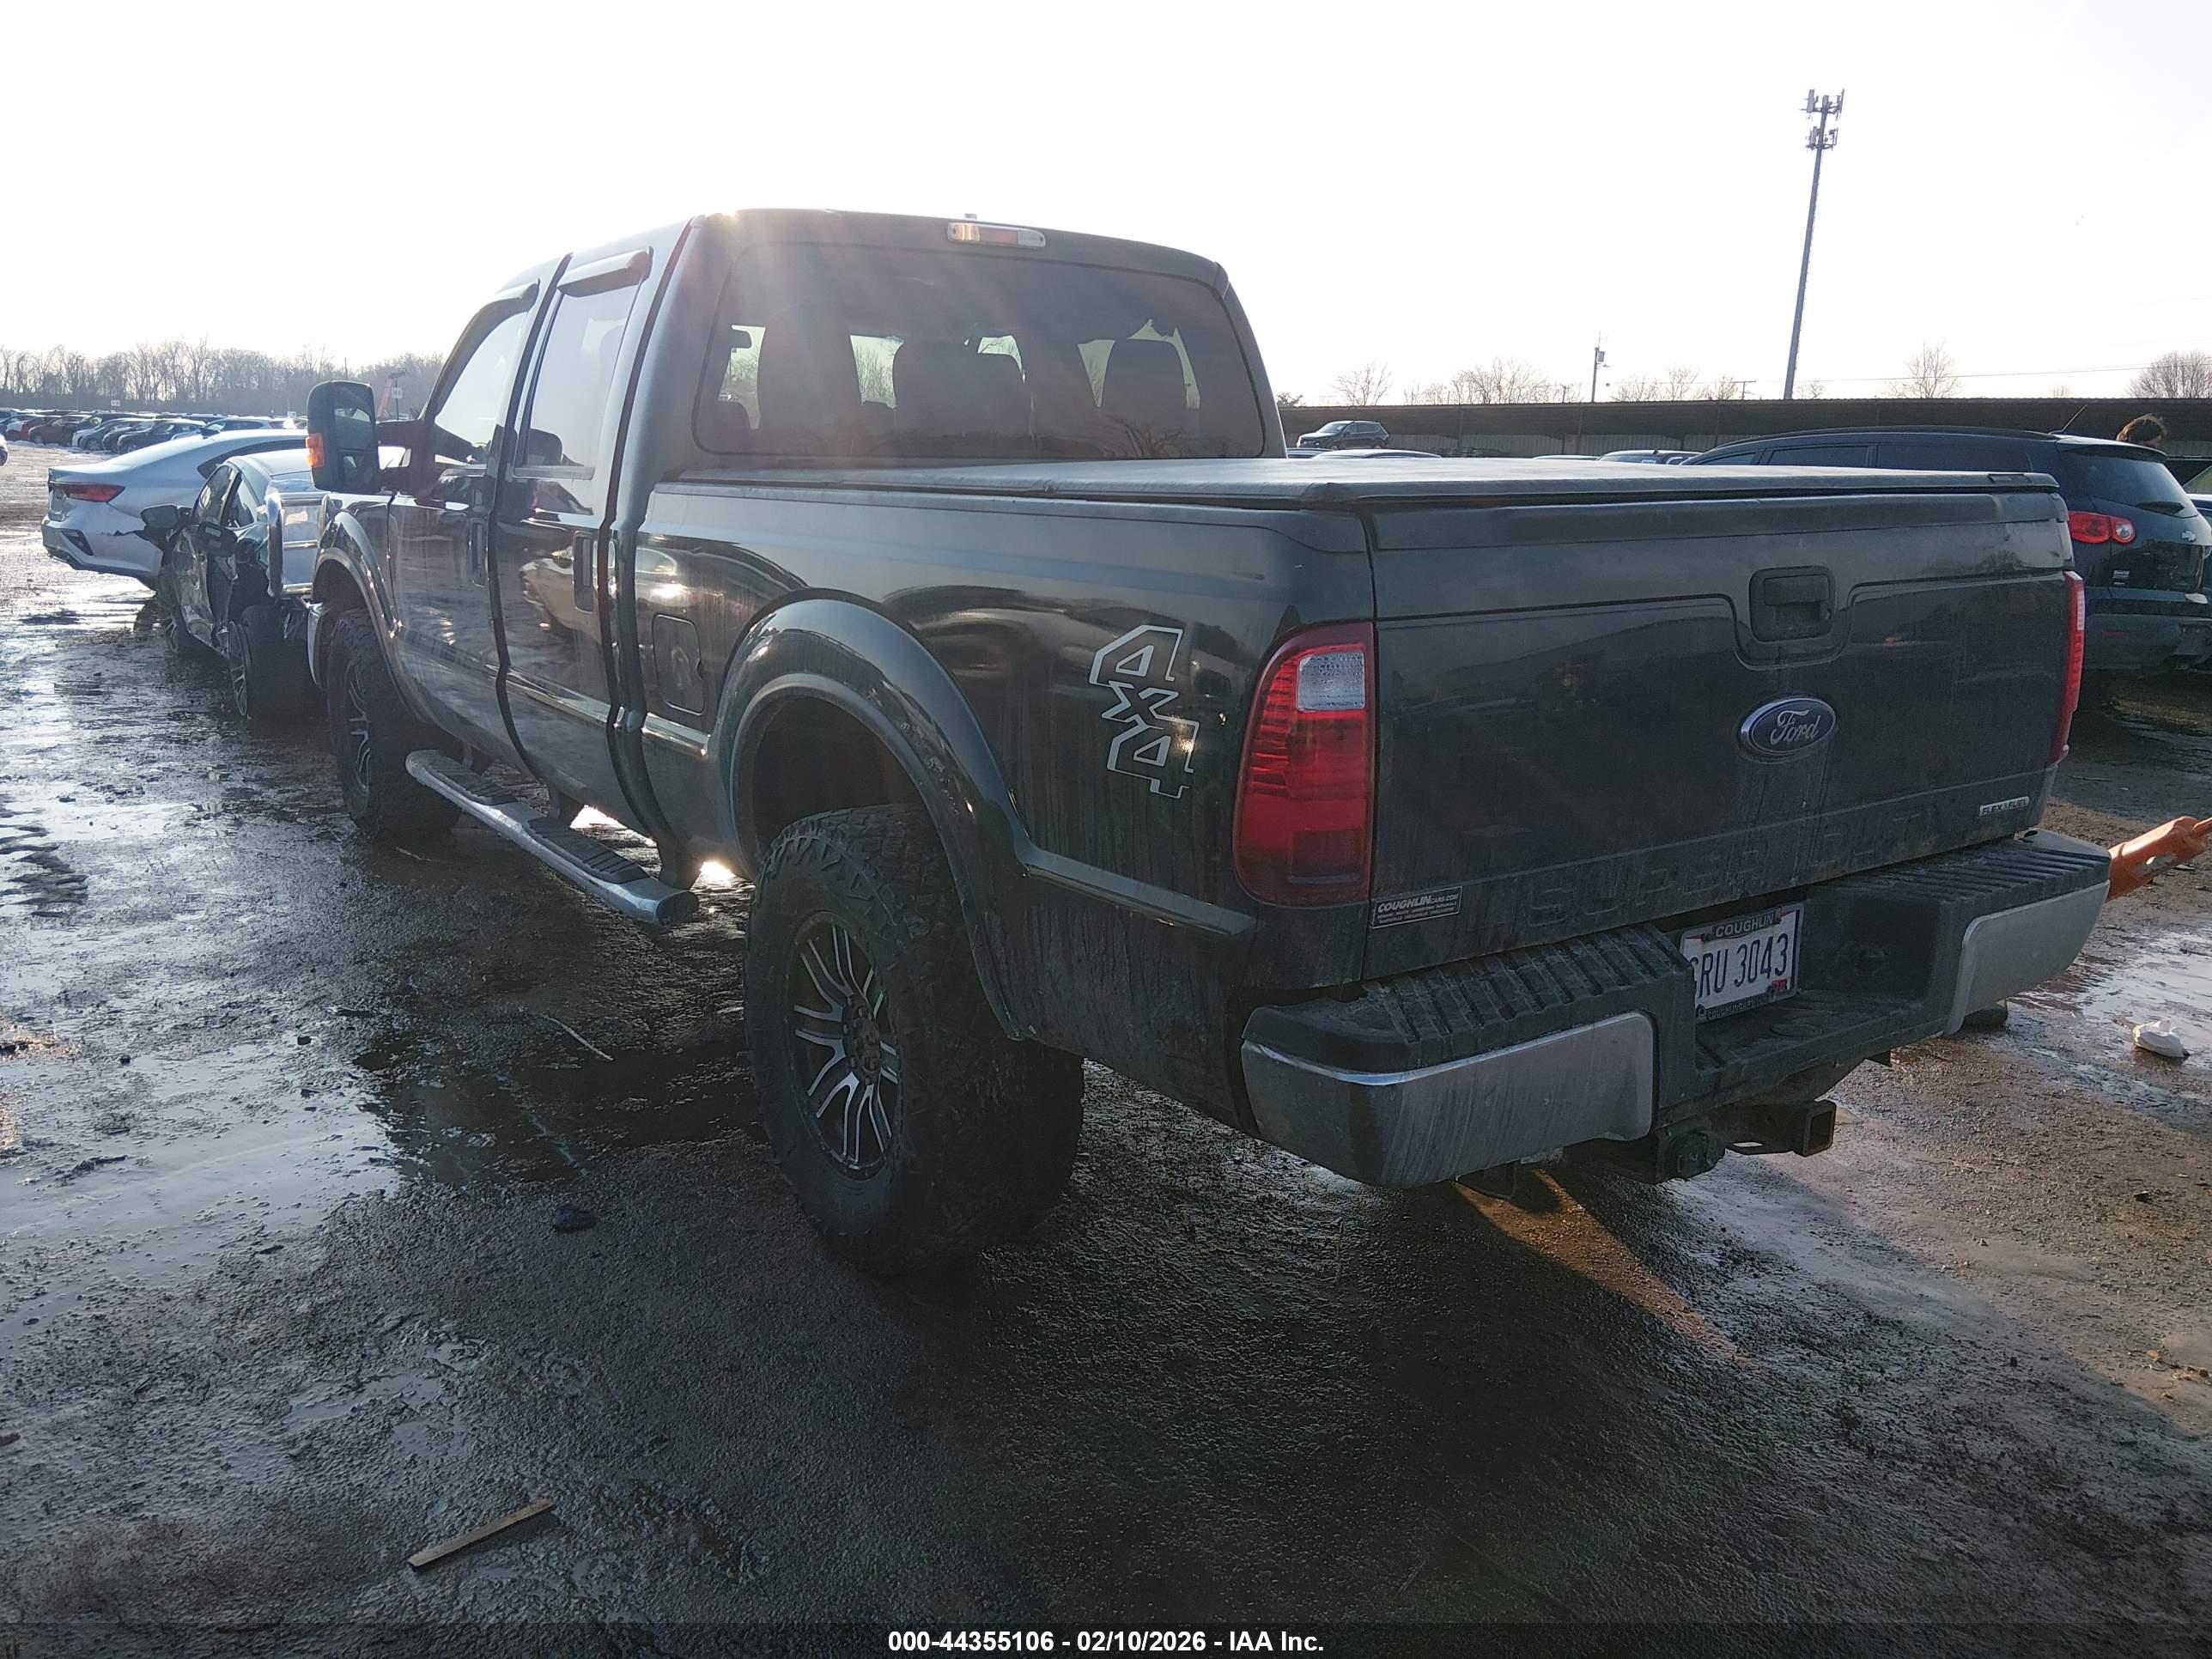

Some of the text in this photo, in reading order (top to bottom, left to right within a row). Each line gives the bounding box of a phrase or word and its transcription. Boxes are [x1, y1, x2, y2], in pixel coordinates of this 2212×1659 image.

[1770, 709, 1821, 745] Ford
[1982, 804, 2002, 815] FLEX
[1715, 912, 1774, 938] COUGHLIN
[1690, 933, 1789, 998] RU 3043
